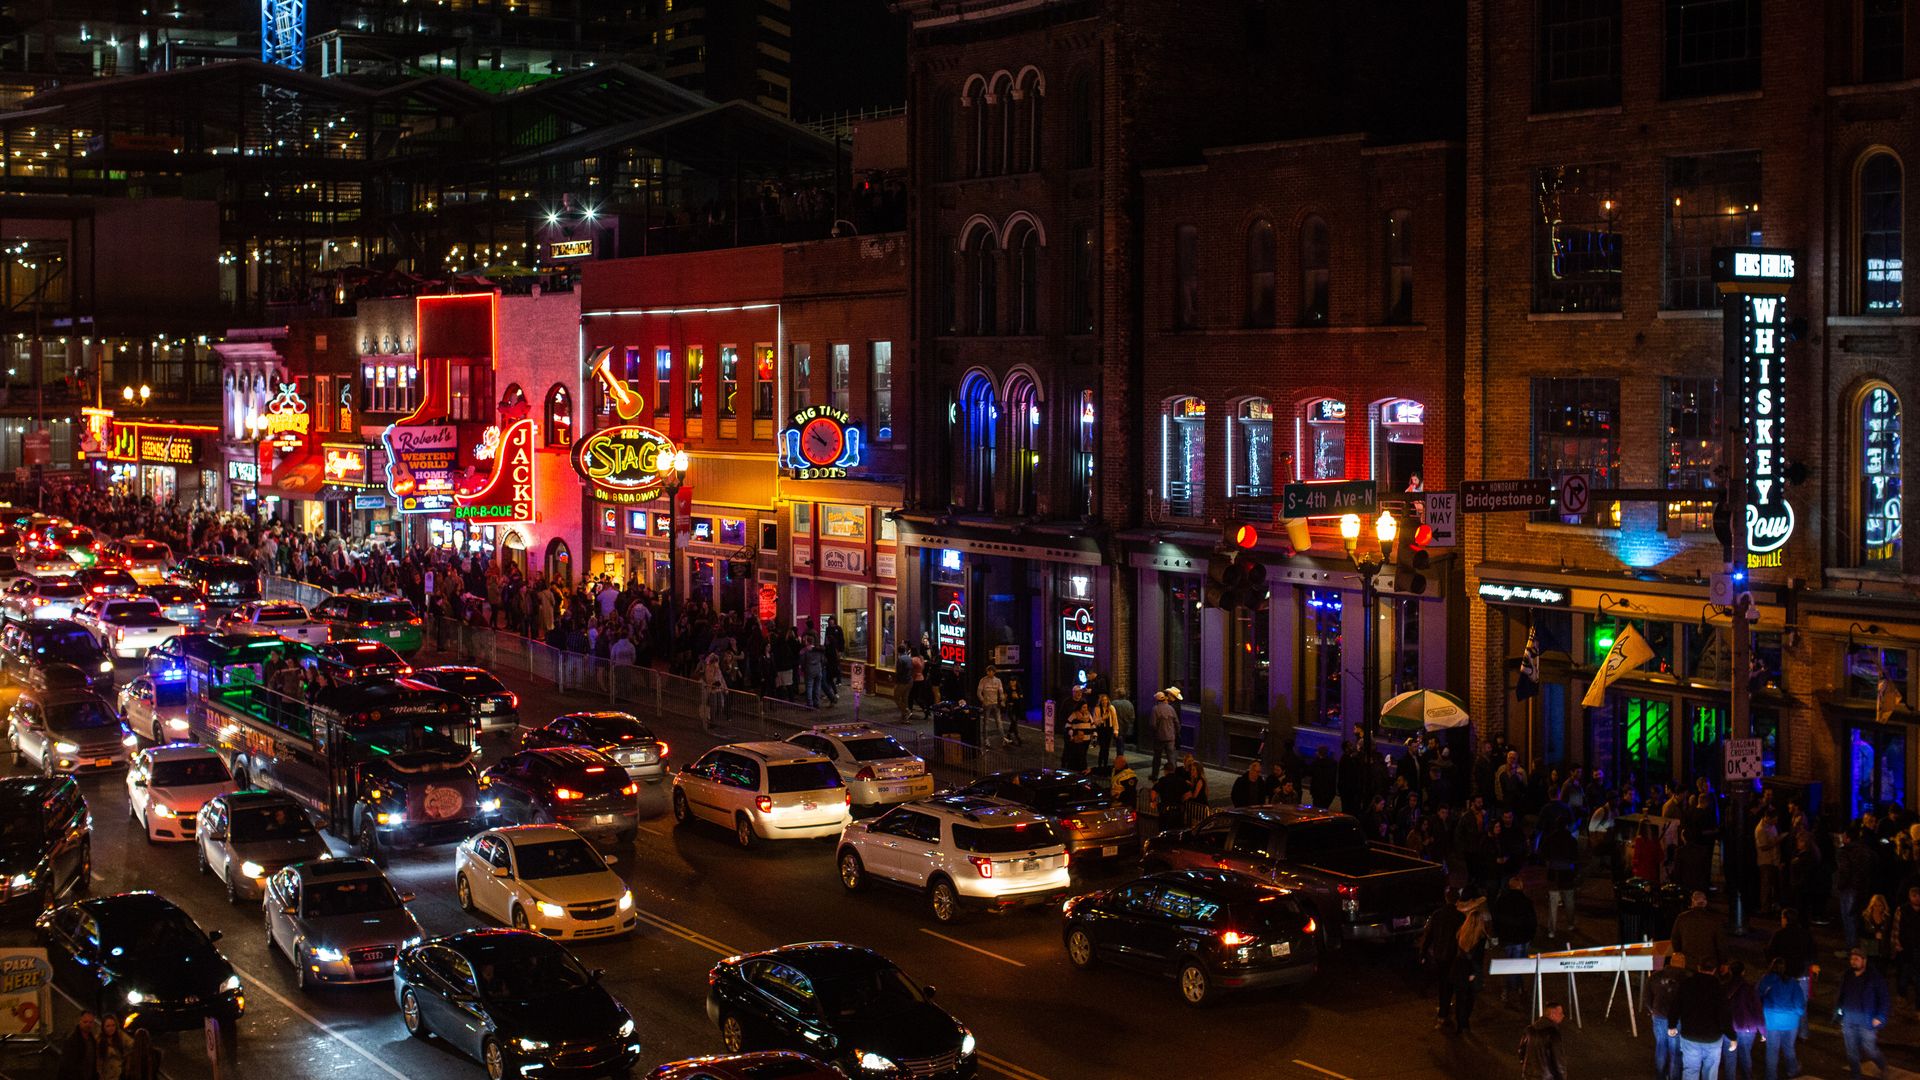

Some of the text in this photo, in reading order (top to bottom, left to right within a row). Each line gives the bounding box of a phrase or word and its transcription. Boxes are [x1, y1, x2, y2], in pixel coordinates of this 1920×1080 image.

[1752, 298, 1777, 504] WHISKEY
[795, 406, 849, 424] BIG TIME
[399, 427, 453, 451] Robert's
[621, 429, 639, 439] THE
[170, 443, 189, 459] GIFTS
[402, 452, 455, 461] WESTERN
[409, 461, 448, 470] WORLD
[415, 471, 448, 479] HOME
[511, 428, 531, 520] JACKS
[800, 467, 847, 479] BOOTS
[1489, 482, 1519, 492] HONORARY
[596, 488, 660, 502] ON BROADWAY
[1430, 495, 1451, 509] ONE
[1465, 493, 1546, 511] Bridgestone Dr
[455, 505, 512, 519] BAR-B-QUE
[1430, 511, 1453, 525] WAY
[827, 560, 844, 568] BOOTS
[1747, 549, 1783, 568] ASHVILLE
[1728, 759, 1741, 774] OK
[3, 957, 35, 973] PARK
